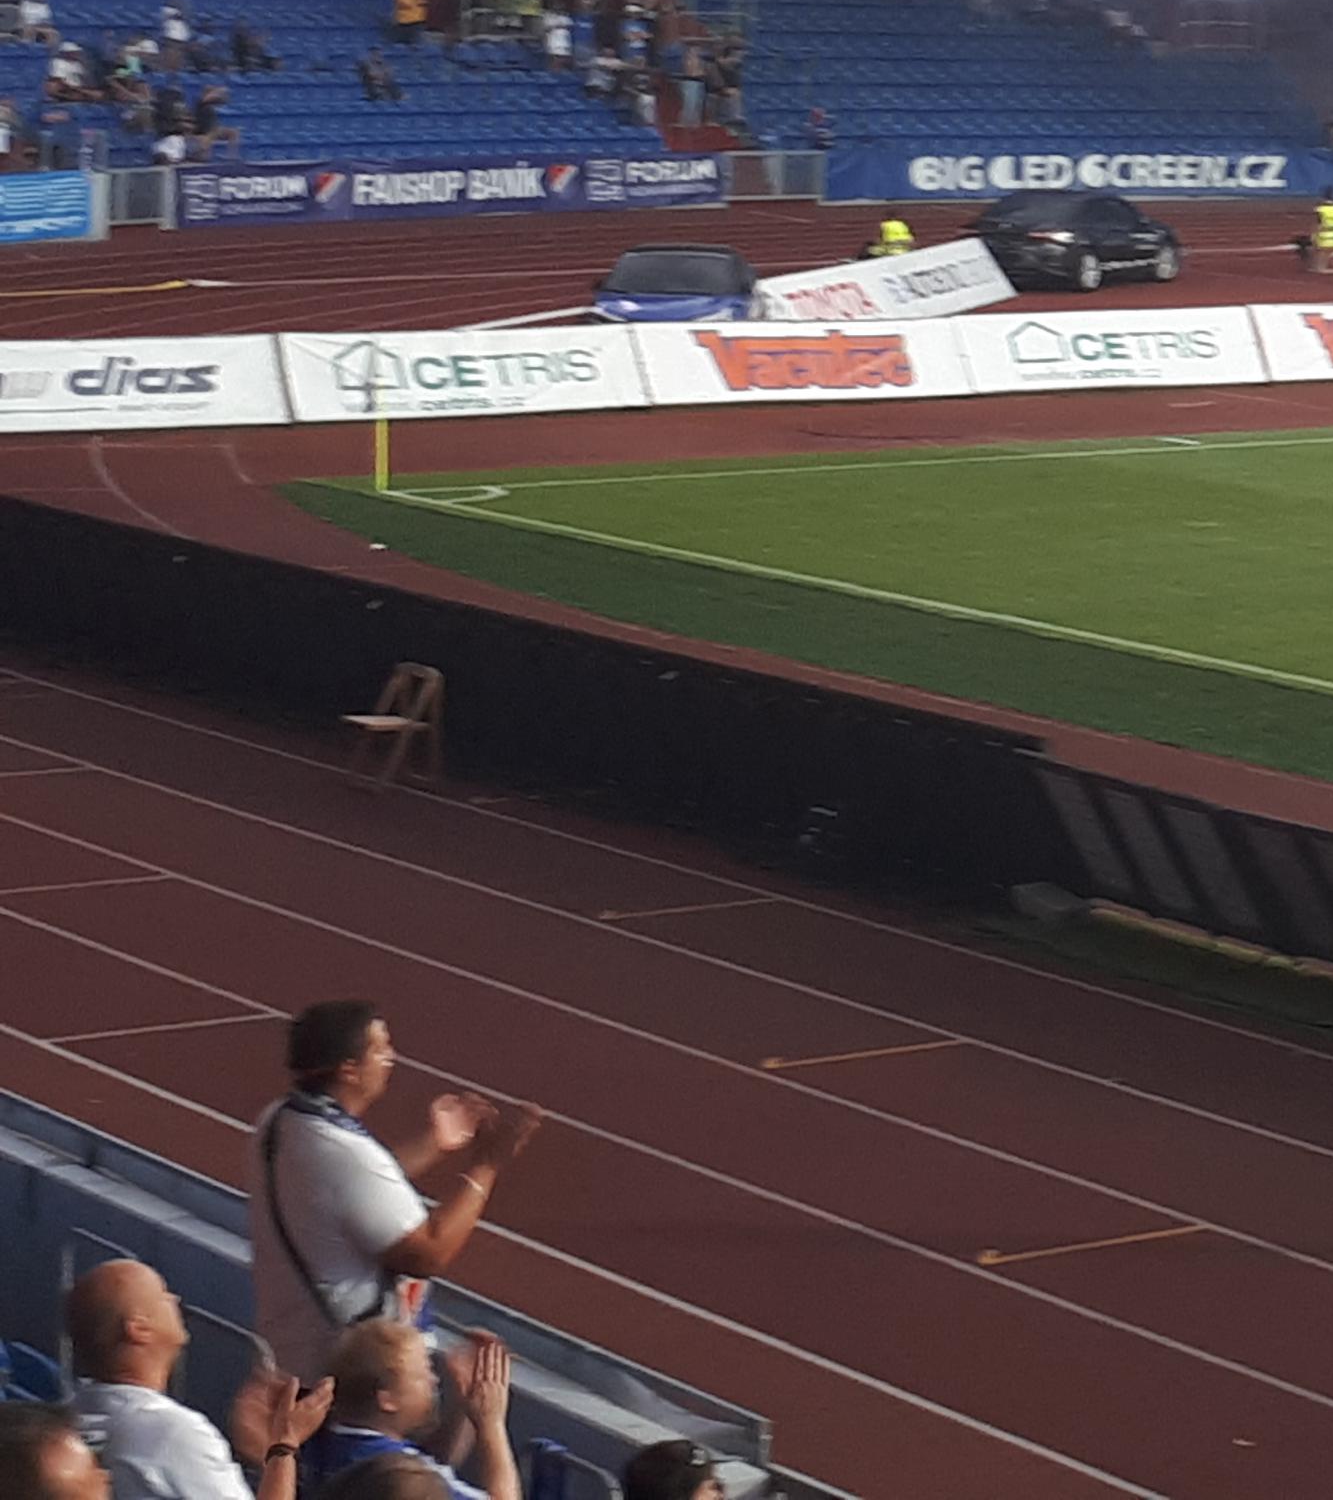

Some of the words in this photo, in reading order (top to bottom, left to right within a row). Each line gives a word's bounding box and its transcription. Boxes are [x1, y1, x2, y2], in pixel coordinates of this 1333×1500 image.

[219, 175, 308, 199] FORUM
[352, 170, 466, 205] FANSHOP
[467, 160, 547, 199] BANÍK
[626, 159, 718, 184] FORUM
[1071, 329, 1221, 361] CETRIS
[411, 349, 600, 390] CETRIS
